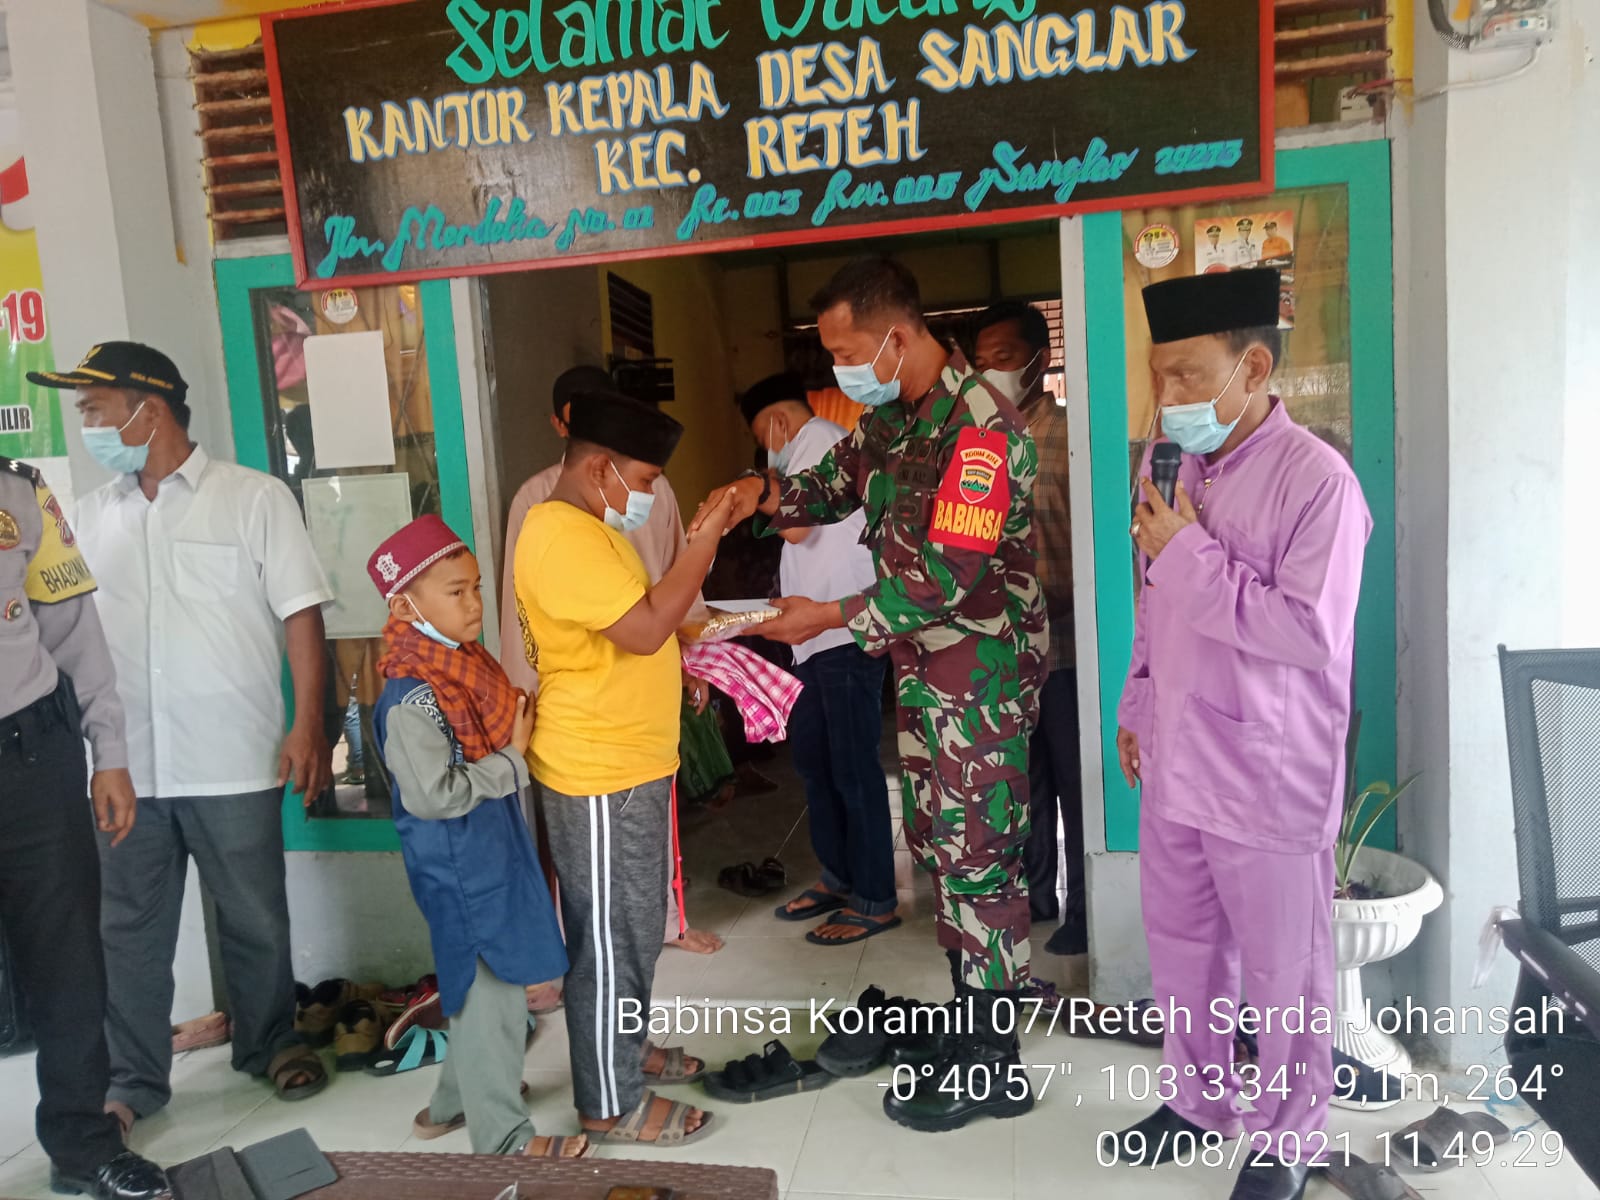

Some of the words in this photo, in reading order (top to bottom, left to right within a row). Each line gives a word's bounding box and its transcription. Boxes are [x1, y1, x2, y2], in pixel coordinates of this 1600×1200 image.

[343, 86, 534, 163] KANTOR
[545, 62, 730, 137] KEPALA
[756, 37, 897, 111] DESA
[917, 0, 1196, 89] SANGLAR
[594, 130, 702, 195] KEC.
[744, 97, 929, 179] RETEH
[743, 188, 803, 219] 003
[893, 171, 962, 205] 005
[0, 407, 31, 431] ILIR
[933, 499, 1003, 542] BABINSA
